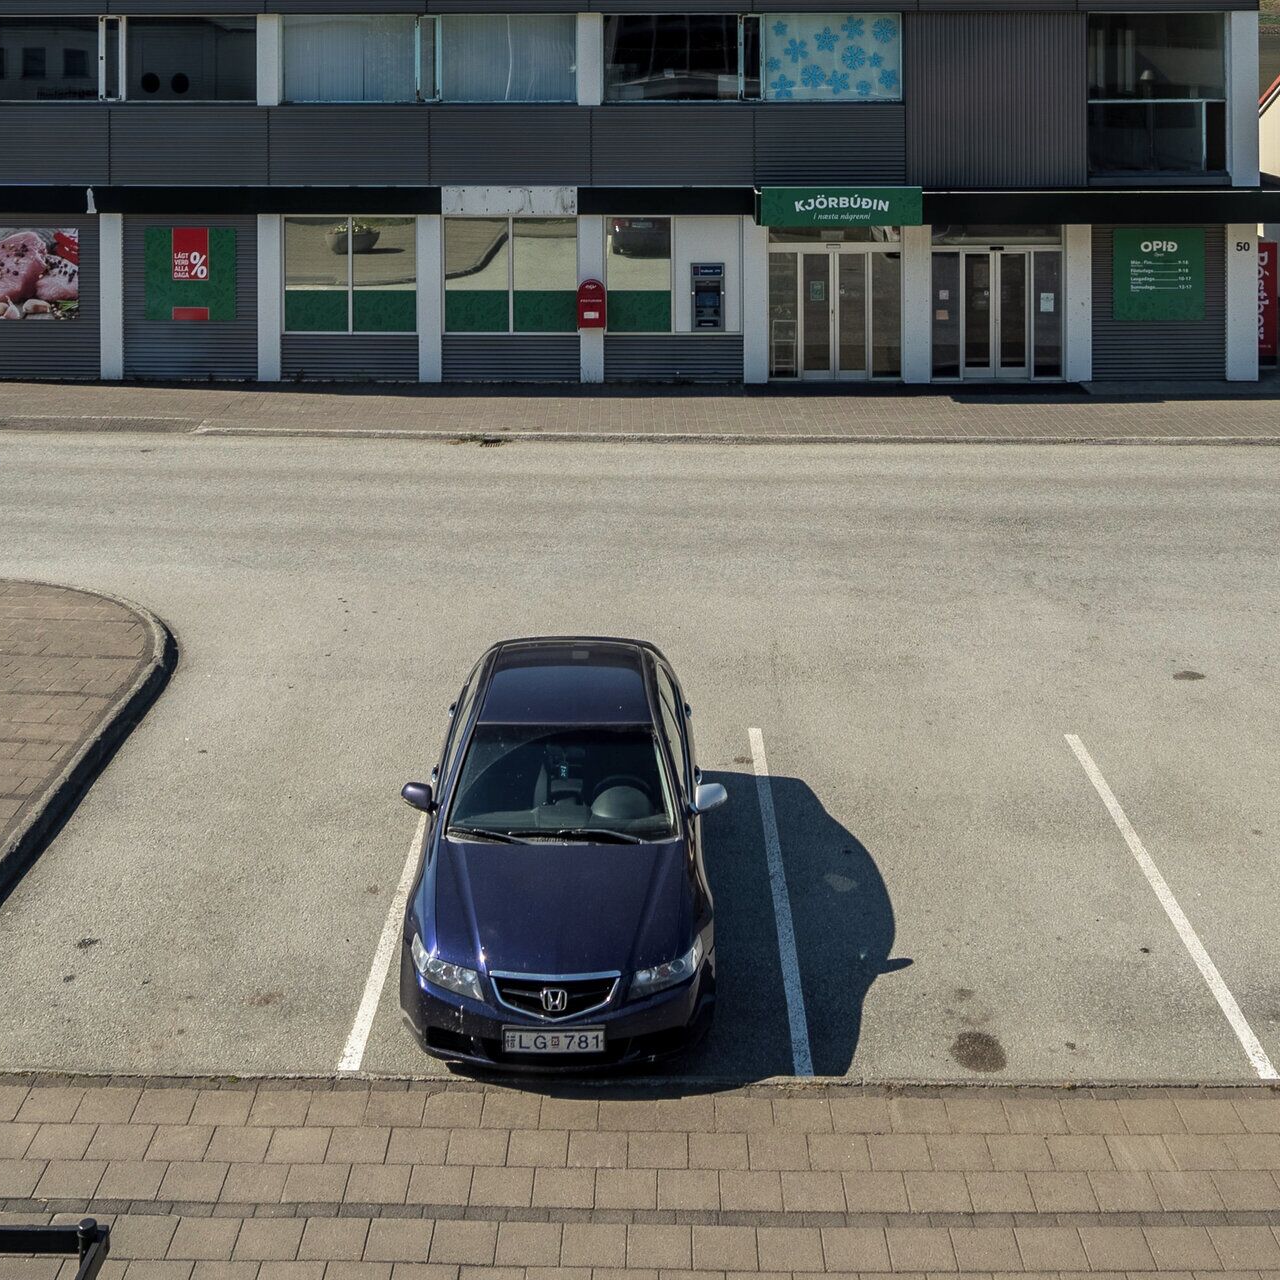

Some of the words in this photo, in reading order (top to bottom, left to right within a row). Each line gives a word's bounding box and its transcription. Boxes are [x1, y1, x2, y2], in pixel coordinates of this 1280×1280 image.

[794, 194, 890, 212] KJÖRBÚÐIN
[1140, 241, 1178, 252] OPIÐ
[1236, 242, 1250, 251] 50
[519, 1035, 547, 1049] LG
[564, 1035, 599, 1049] 781
